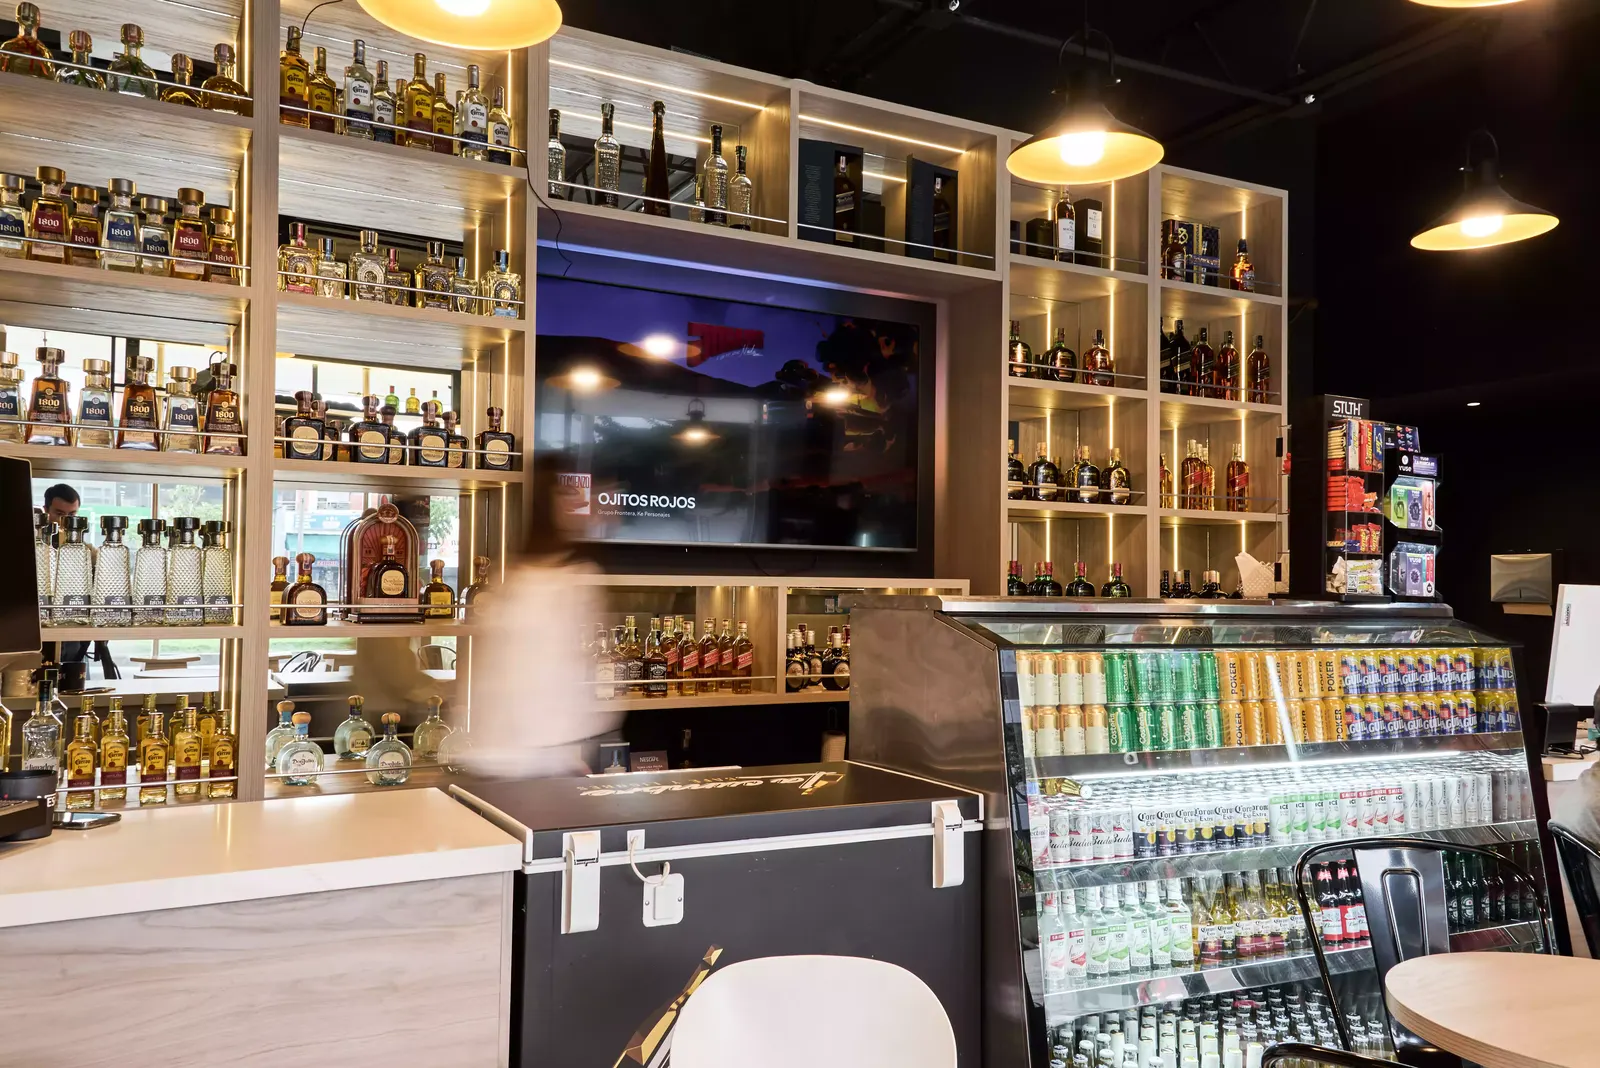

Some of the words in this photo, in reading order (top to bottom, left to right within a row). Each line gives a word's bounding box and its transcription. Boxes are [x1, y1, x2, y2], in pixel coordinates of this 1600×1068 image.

[38, 218, 59, 227] 1800
[111, 228, 131, 237] 1800
[74, 234, 95, 244] 1800
[180, 236, 199, 245] 1800
[146, 244, 166, 253] 1800
[215, 254, 233, 262] 1800
[38, 398, 60, 406] 1800
[86, 407, 106, 415] 1800
[130, 405, 150, 413] 1800
[1333, 400, 1361, 416] STLTH
[175, 413, 194, 421] 1800
[215, 410, 235, 418] 1800
[598, 492, 648, 507] OJITOS
[650, 495, 696, 509] ROJOS
[1229, 662, 1238, 695] POKER
[1326, 661, 1335, 692] POKER
[1335, 709, 1343, 740] POKER
[1235, 713, 1243, 746] POKER
